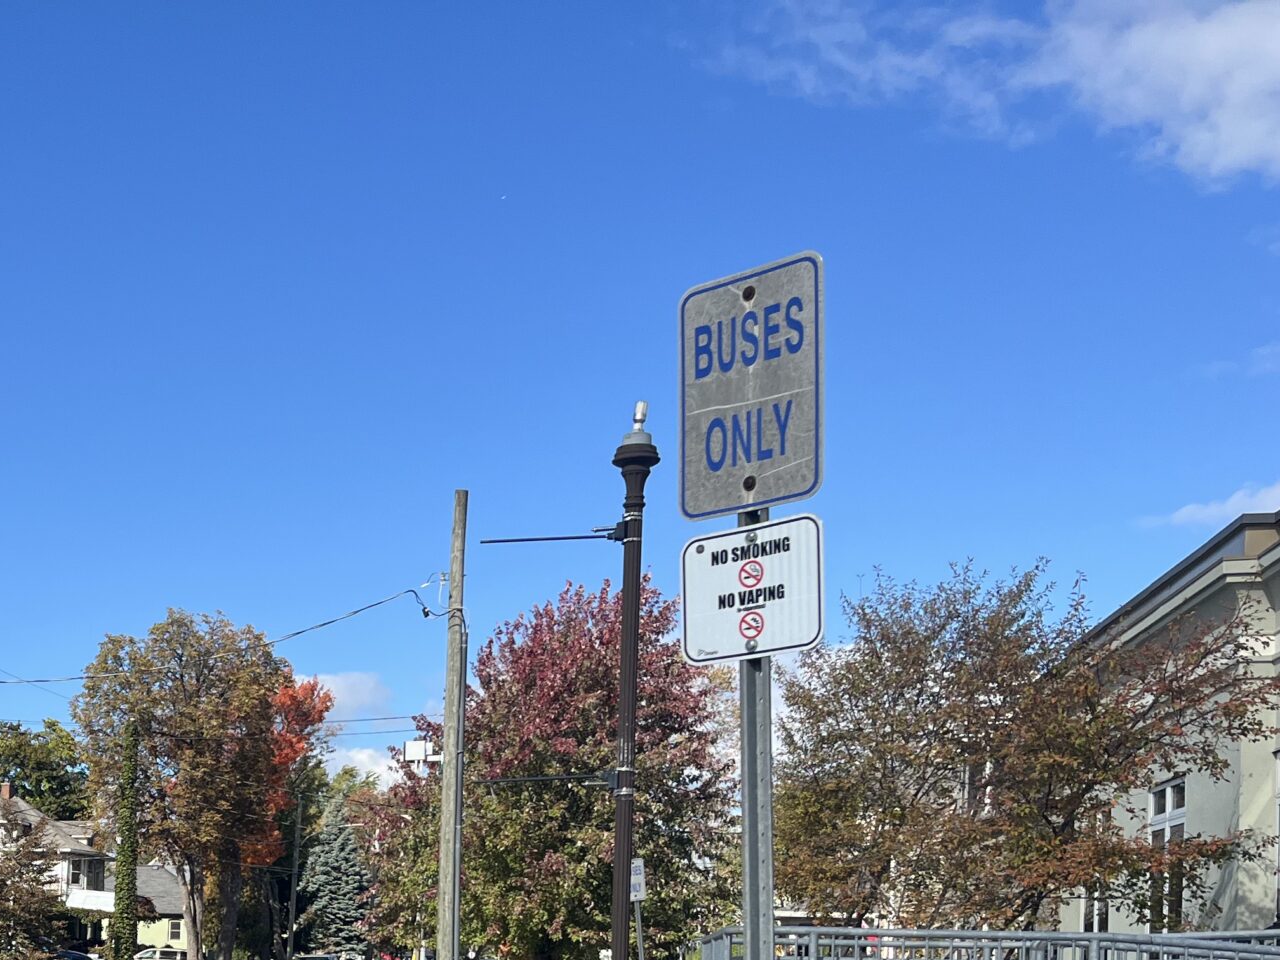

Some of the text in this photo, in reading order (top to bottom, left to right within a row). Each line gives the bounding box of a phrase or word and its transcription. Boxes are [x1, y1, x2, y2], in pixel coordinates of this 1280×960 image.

[694, 296, 804, 380] BUSES
[705, 399, 793, 473] ONLY
[711, 536, 791, 567] NO SMOKING
[718, 592, 735, 610] NO
[738, 584, 785, 606] VAPING
